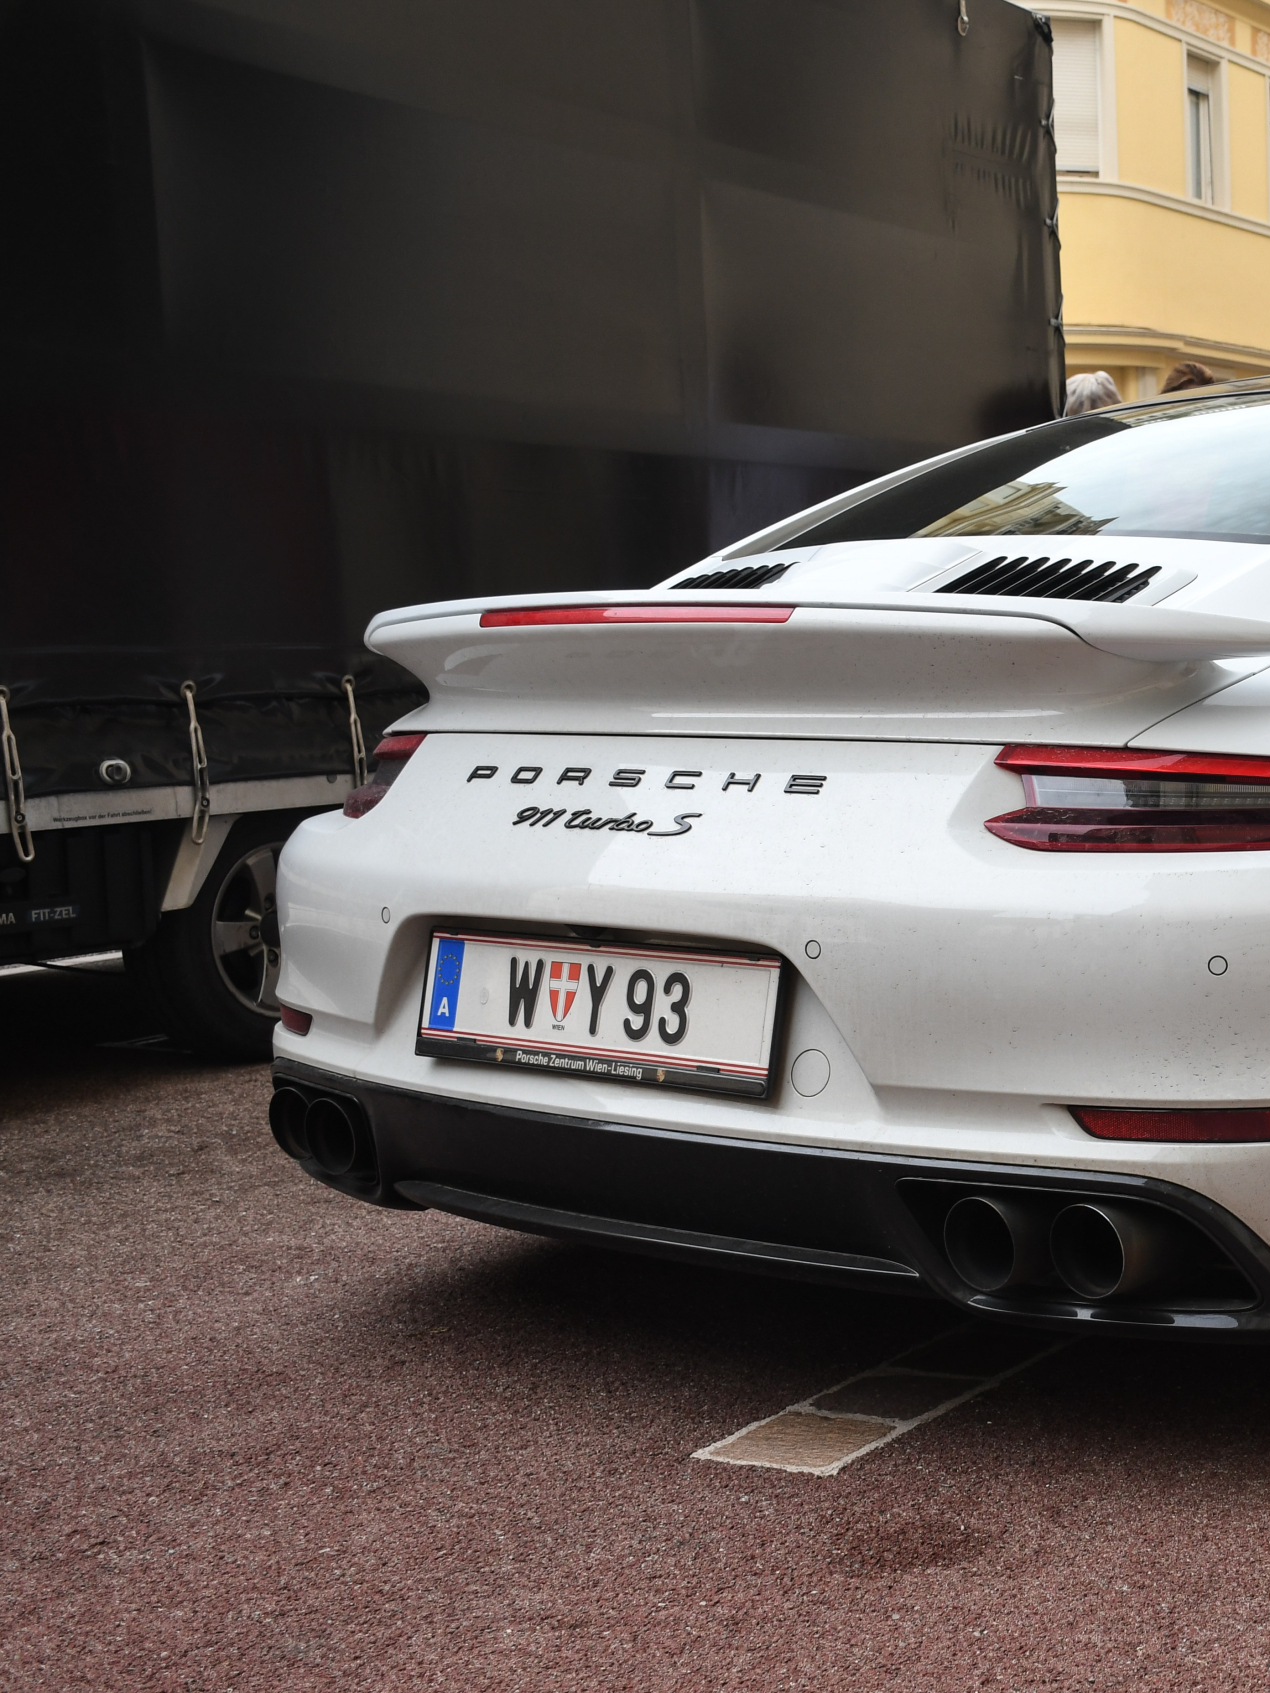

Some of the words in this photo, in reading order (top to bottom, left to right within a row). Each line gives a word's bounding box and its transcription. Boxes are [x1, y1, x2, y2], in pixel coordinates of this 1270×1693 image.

[466, 765, 827, 795] PORSCHE
[53, 815, 88, 823] Werkzeugbox
[512, 806, 567, 827] 911
[564, 808, 653, 833] turbo
[647, 812, 703, 837] S
[32, 906, 77, 922] FIT-ZEL
[436, 997, 450, 1017] A
[551, 1023, 566, 1031] WIEN
[515, 1050, 548, 1066] Porsche
[549, 1055, 585, 1070] Zentrum
[586, 1060, 643, 1080] Wien-Liesing
